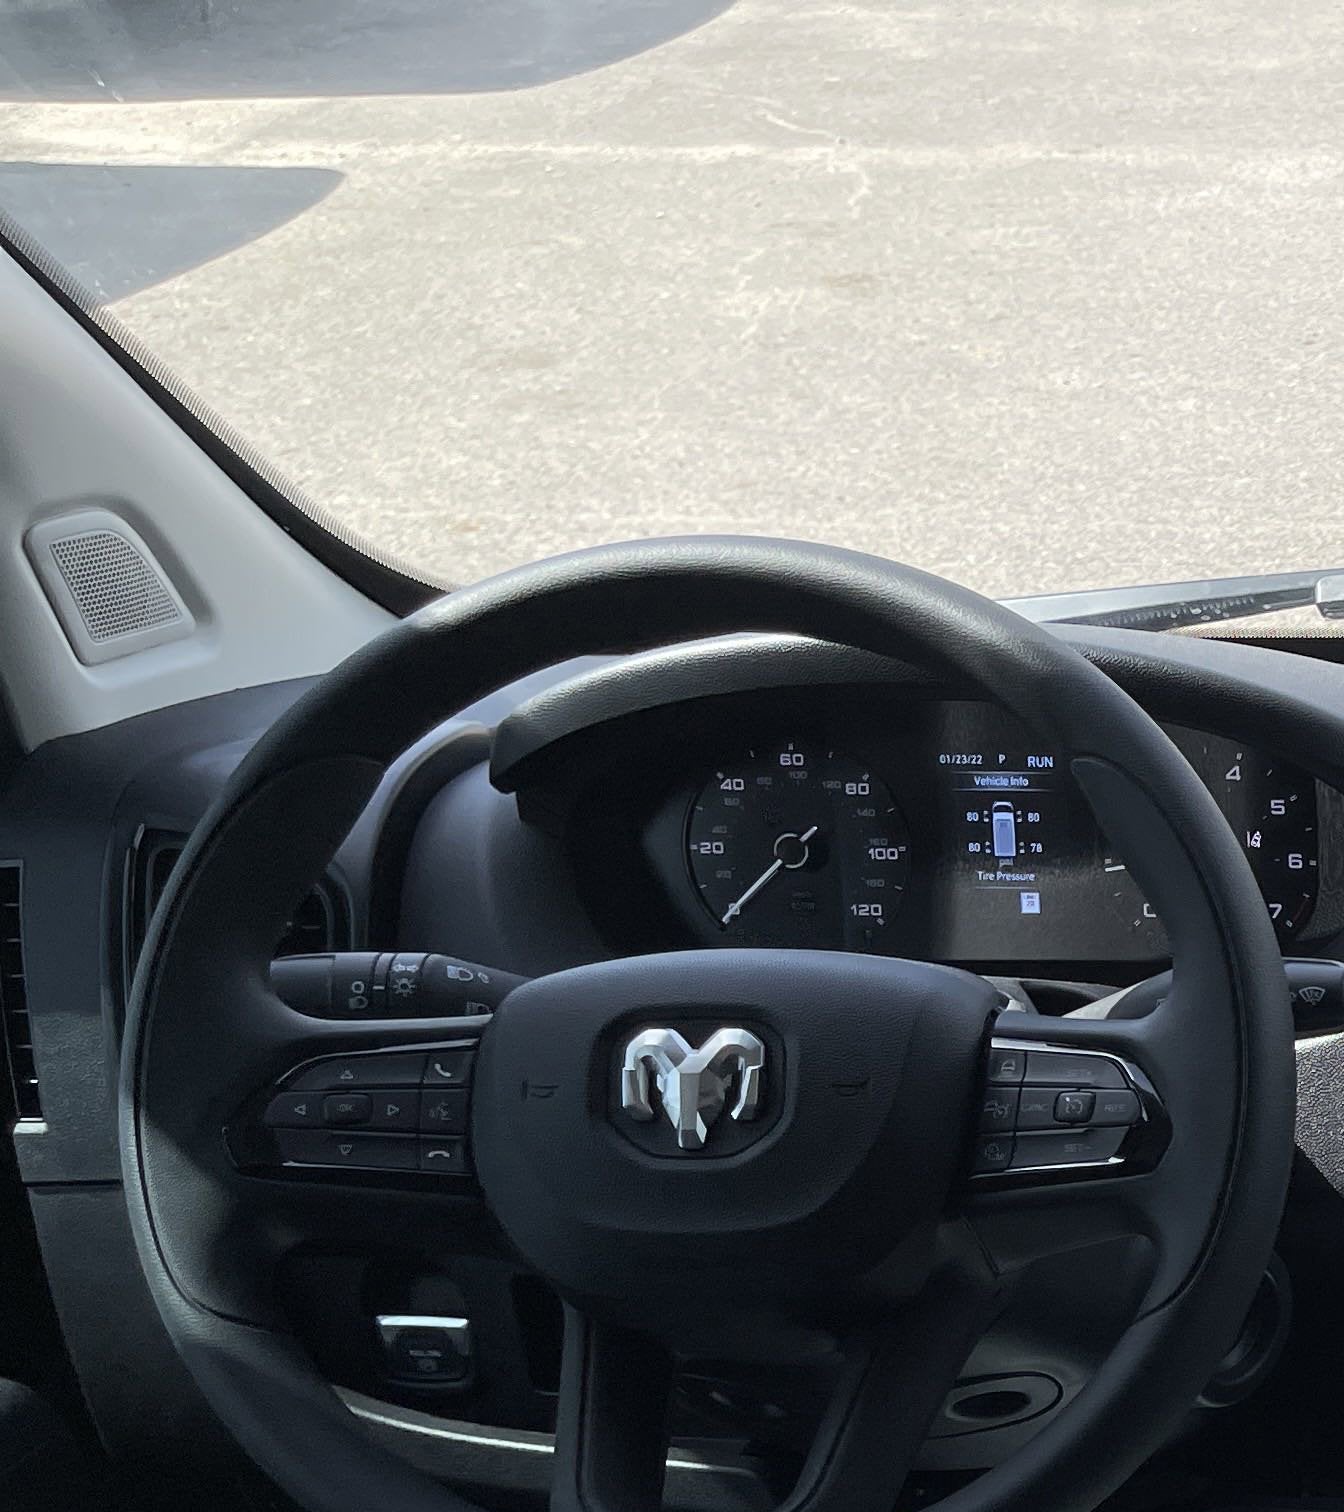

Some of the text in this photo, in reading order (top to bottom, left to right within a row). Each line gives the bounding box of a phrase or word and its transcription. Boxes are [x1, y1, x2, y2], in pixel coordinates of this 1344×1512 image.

[779, 753, 804, 766] 60
[939, 754, 1053, 768] 01/23/22 P RUN
[1225, 765, 1241, 781] 4
[720, 778, 745, 791] 40
[974, 775, 1029, 787] Vehicle Info
[845, 782, 870, 796] 80
[1270, 799, 1286, 816] 5
[700, 841, 725, 854] 20
[868, 848, 899, 861] 100
[1288, 853, 1303, 869] 6
[977, 871, 1035, 882] Tire Pressure
[850, 904, 882, 917] 120
[1268, 903, 1283, 919] 7
